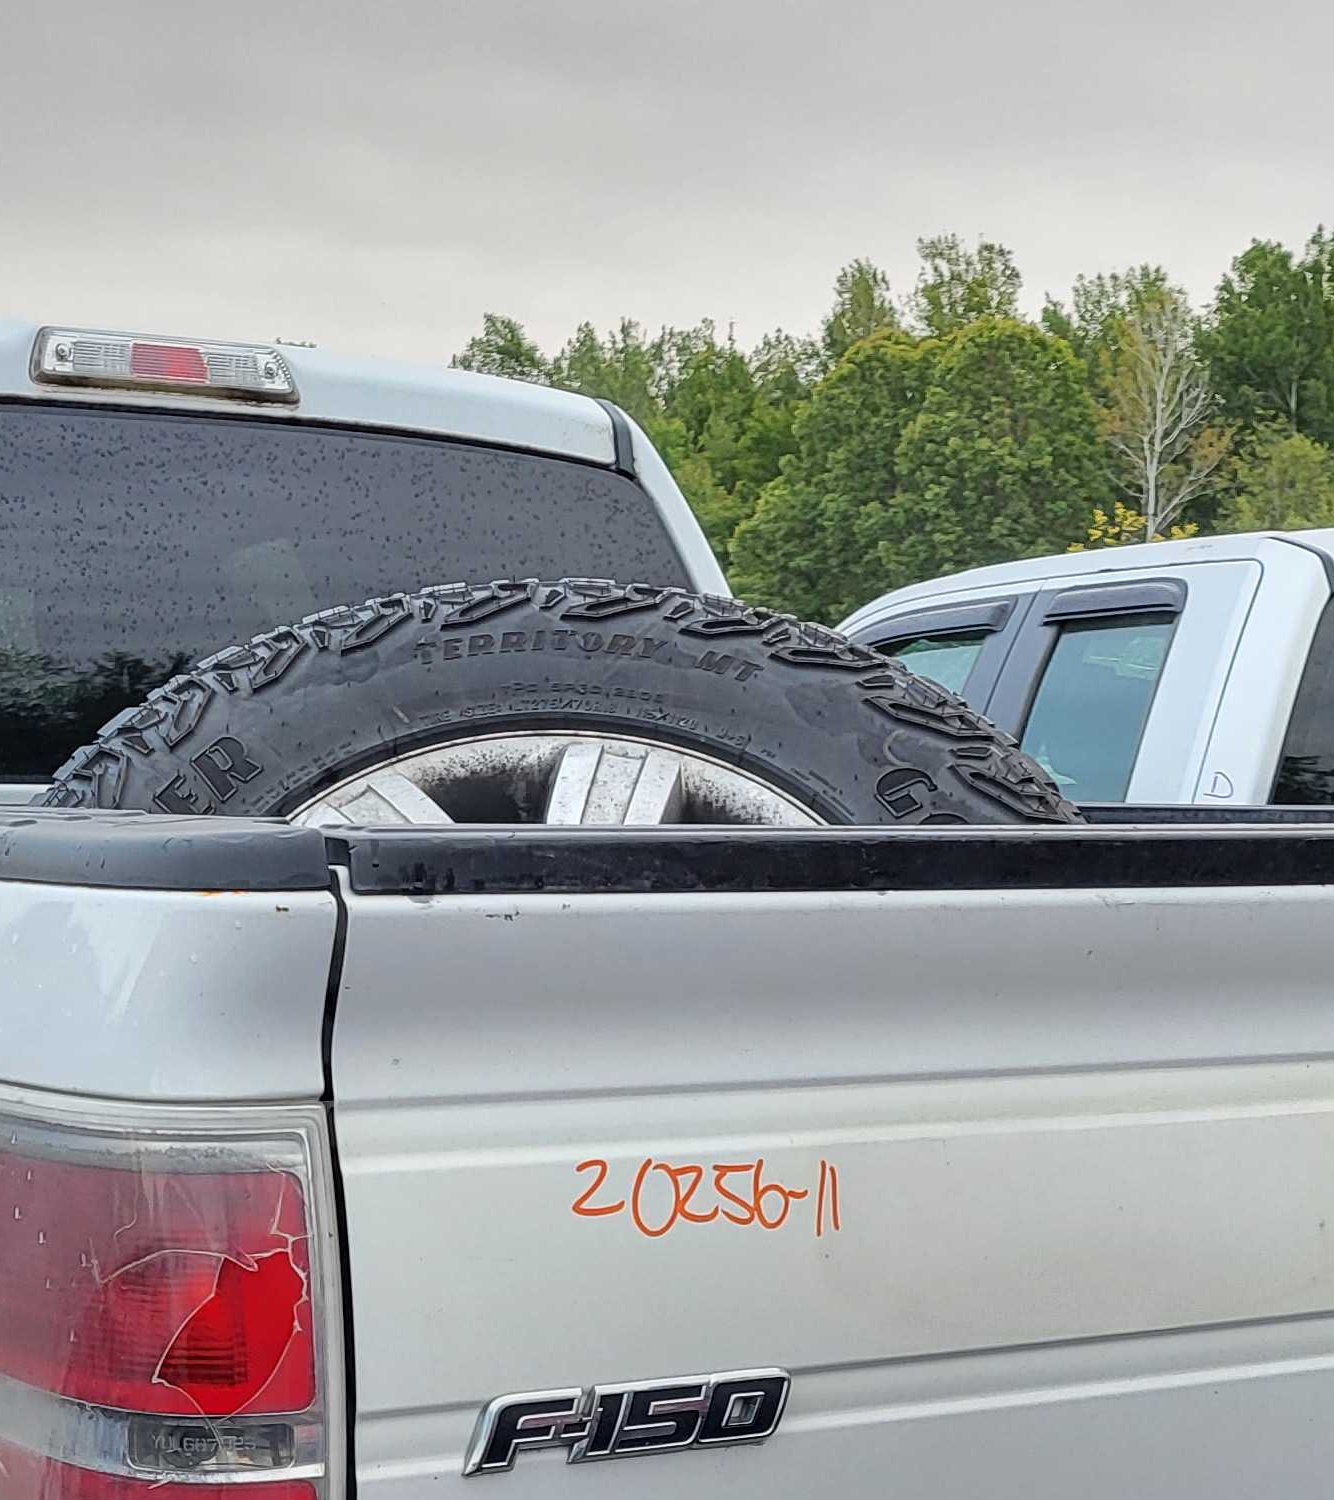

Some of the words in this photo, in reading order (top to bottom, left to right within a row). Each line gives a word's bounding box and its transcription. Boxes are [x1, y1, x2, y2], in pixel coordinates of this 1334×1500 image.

[415, 629, 668, 664] TERRITORY
[695, 649, 765, 682] MT
[572, 1158, 840, 1238] 20256-11
[462, 1366, 793, 1477] F-150
